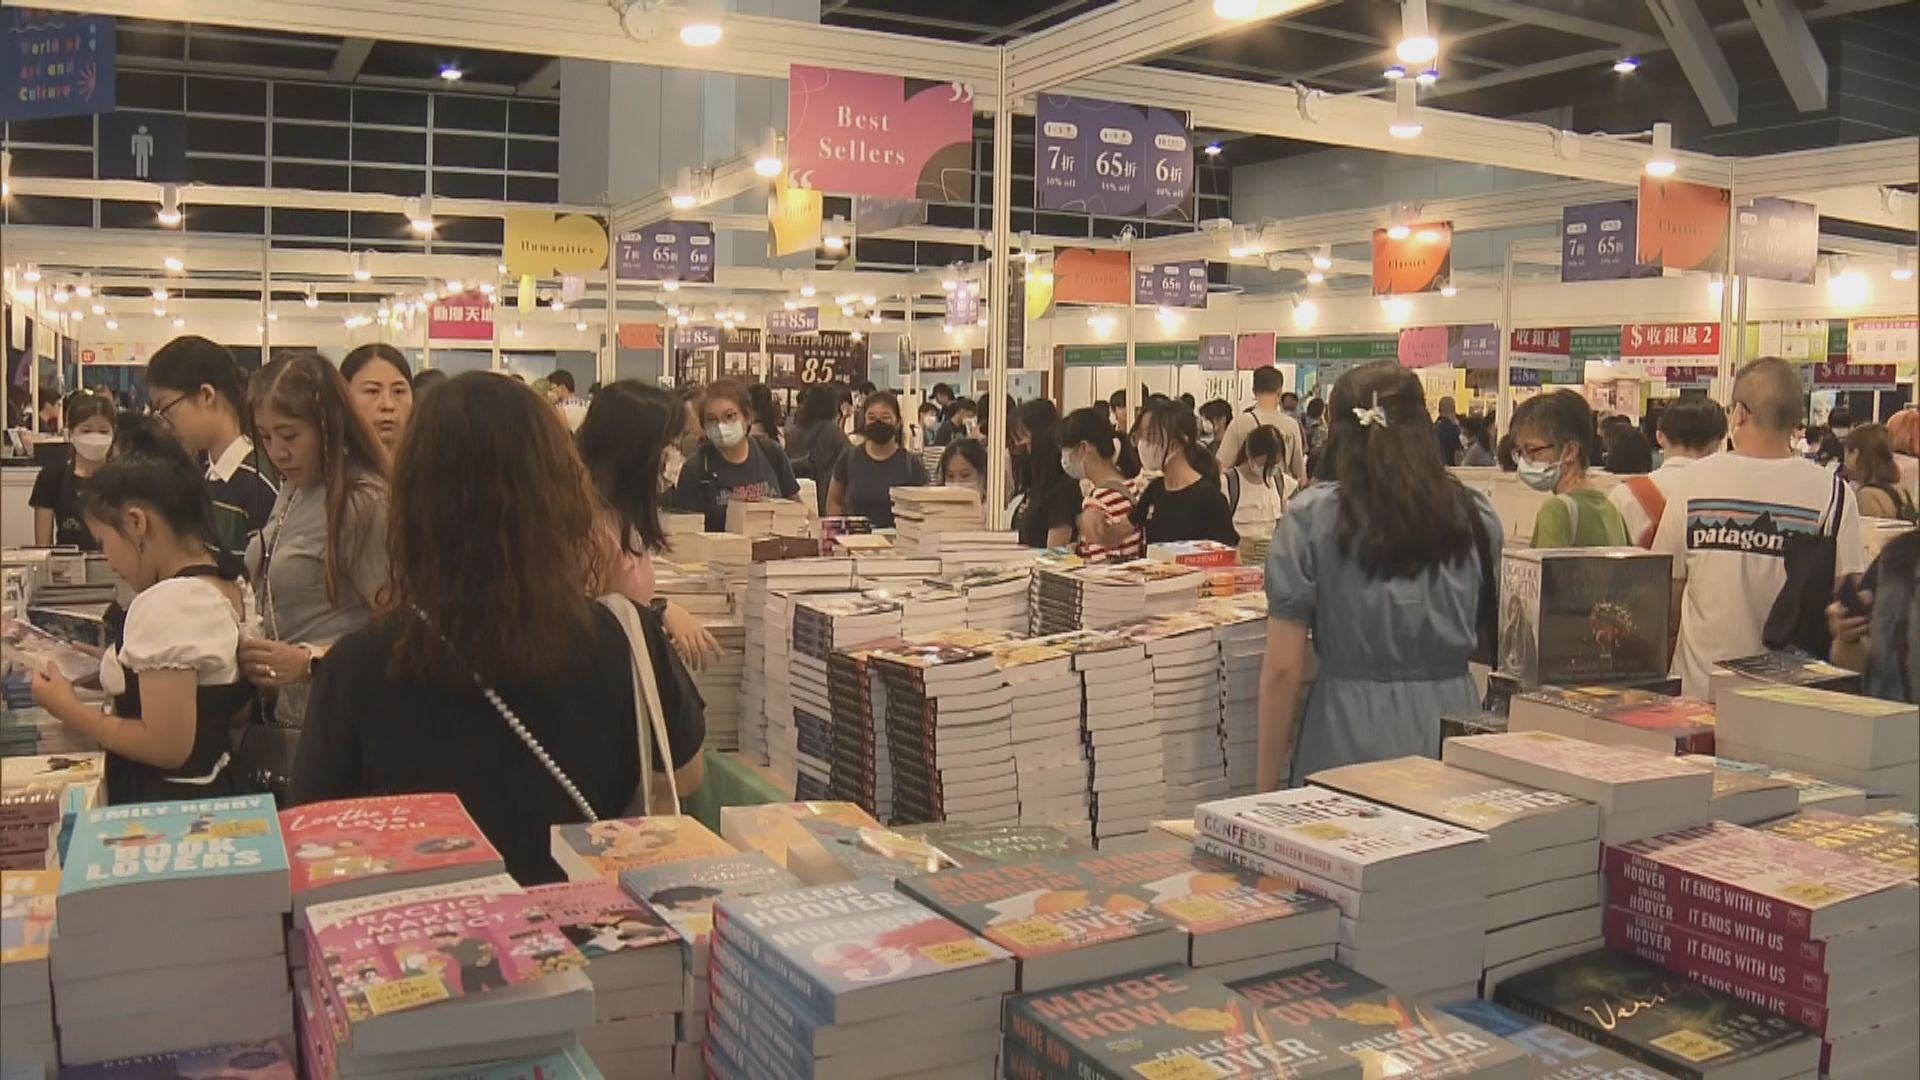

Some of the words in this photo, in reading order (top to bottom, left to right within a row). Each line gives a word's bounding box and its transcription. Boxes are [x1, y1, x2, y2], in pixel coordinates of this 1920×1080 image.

[836, 104, 890, 132] Best
[818, 136, 906, 166] Sellers
[1095, 152, 1138, 178] 65折
[1155, 157, 1183, 183] 6折
[521, 239, 595, 255] Humanities
[1630, 325, 1643, 349] $
[1702, 325, 1713, 344] 2
[90, 804, 170, 823] EMILY
[180, 797, 263, 814] HENRY
[1203, 814, 1268, 852] CONFESS
[85, 849, 263, 881] LOVERS
[113, 837, 237, 862] BOOK
[927, 862, 1062, 894] MAYBE
[940, 872, 1087, 907] SOMEDAY
[1623, 863, 1666, 891] HOOVER
[333, 893, 503, 930] PRACTICE
[743, 890, 908, 928] HOOVER
[751, 884, 861, 911] COLLEEN
[1629, 895, 1674, 922] HOOVER
[1680, 876, 1691, 894] IT
[1692, 878, 1722, 903] ENDS
[1723, 888, 1754, 915] WITH
[1755, 901, 1773, 920] US
[354, 911, 506, 951] PERFECT
[366, 907, 488, 936] MAKES
[772, 907, 941, 949] NOVEMBER
[1057, 908, 1156, 938] OVER
[1626, 922, 1673, 952] HOOVER
[1689, 907, 1700, 925] IT
[1701, 912, 1732, 936] ENDS
[1734, 920, 1765, 946] WITH
[1767, 932, 1785, 952] US
[1687, 937, 1699, 957] IT
[1700, 941, 1732, 968] ENDS
[1734, 952, 1766, 979] WITH
[1768, 964, 1787, 984] US
[1029, 973, 1190, 1020] MAYBE
[1237, 968, 1348, 1006] AYBE
[1060, 1001, 1171, 1041] NOW
[1266, 996, 1340, 1027] OW
[1203, 1038, 1322, 1076] OVER
[1385, 1031, 1490, 1068] OVER
